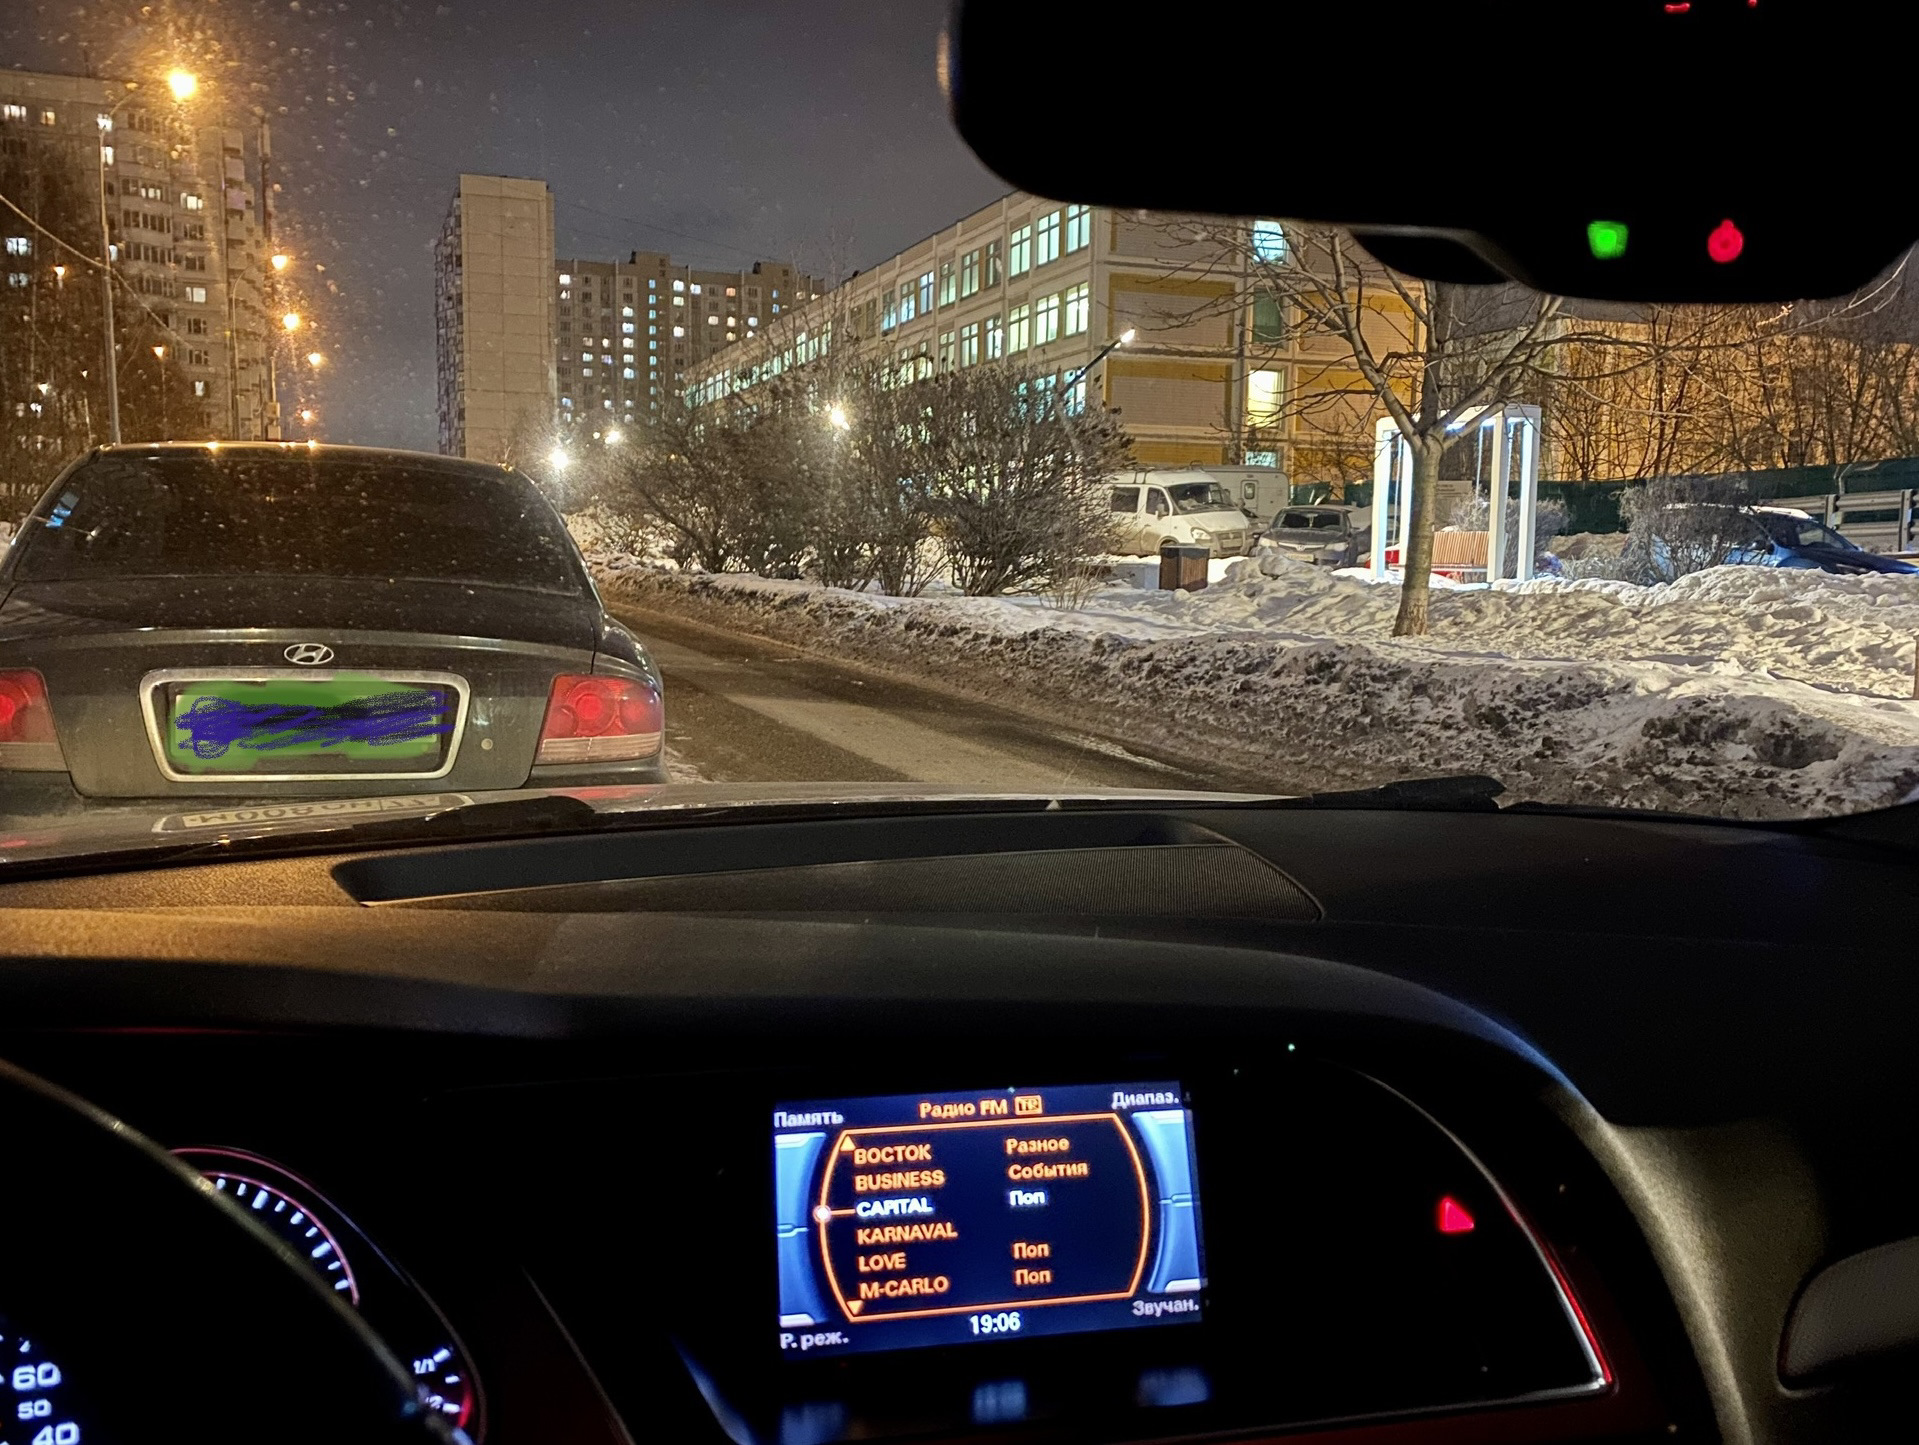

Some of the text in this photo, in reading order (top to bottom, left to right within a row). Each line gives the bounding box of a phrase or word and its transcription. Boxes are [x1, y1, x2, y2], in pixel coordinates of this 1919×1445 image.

[919, 1102, 976, 1119] Радио
[980, 1099, 1008, 1115] FM
[1111, 1091, 1180, 1110] Диапаз.
[773, 1111, 844, 1128] Память
[854, 1144, 932, 1165] ВОСТОК
[1005, 1138, 1070, 1155] Разное
[855, 1169, 945, 1192] BUSINESS
[1008, 1162, 1089, 1181] События
[856, 1197, 934, 1217] CAPITAL
[1010, 1190, 1046, 1206] Поп
[857, 1222, 958, 1245] KARNAVAL
[1013, 1242, 1050, 1260] Поп
[858, 1252, 907, 1273] LOVE
[859, 1276, 950, 1299] M-CARLO
[1015, 1269, 1052, 1286] Поп
[1132, 1298, 1200, 1317] Звучан.
[969, 1311, 1021, 1335] 19:06
[779, 1331, 849, 1351] Р. реж.
[12, 1361, 62, 1392] 60
[17, 1398, 52, 1420] 50
[32, 1421, 80, 1445] 40
